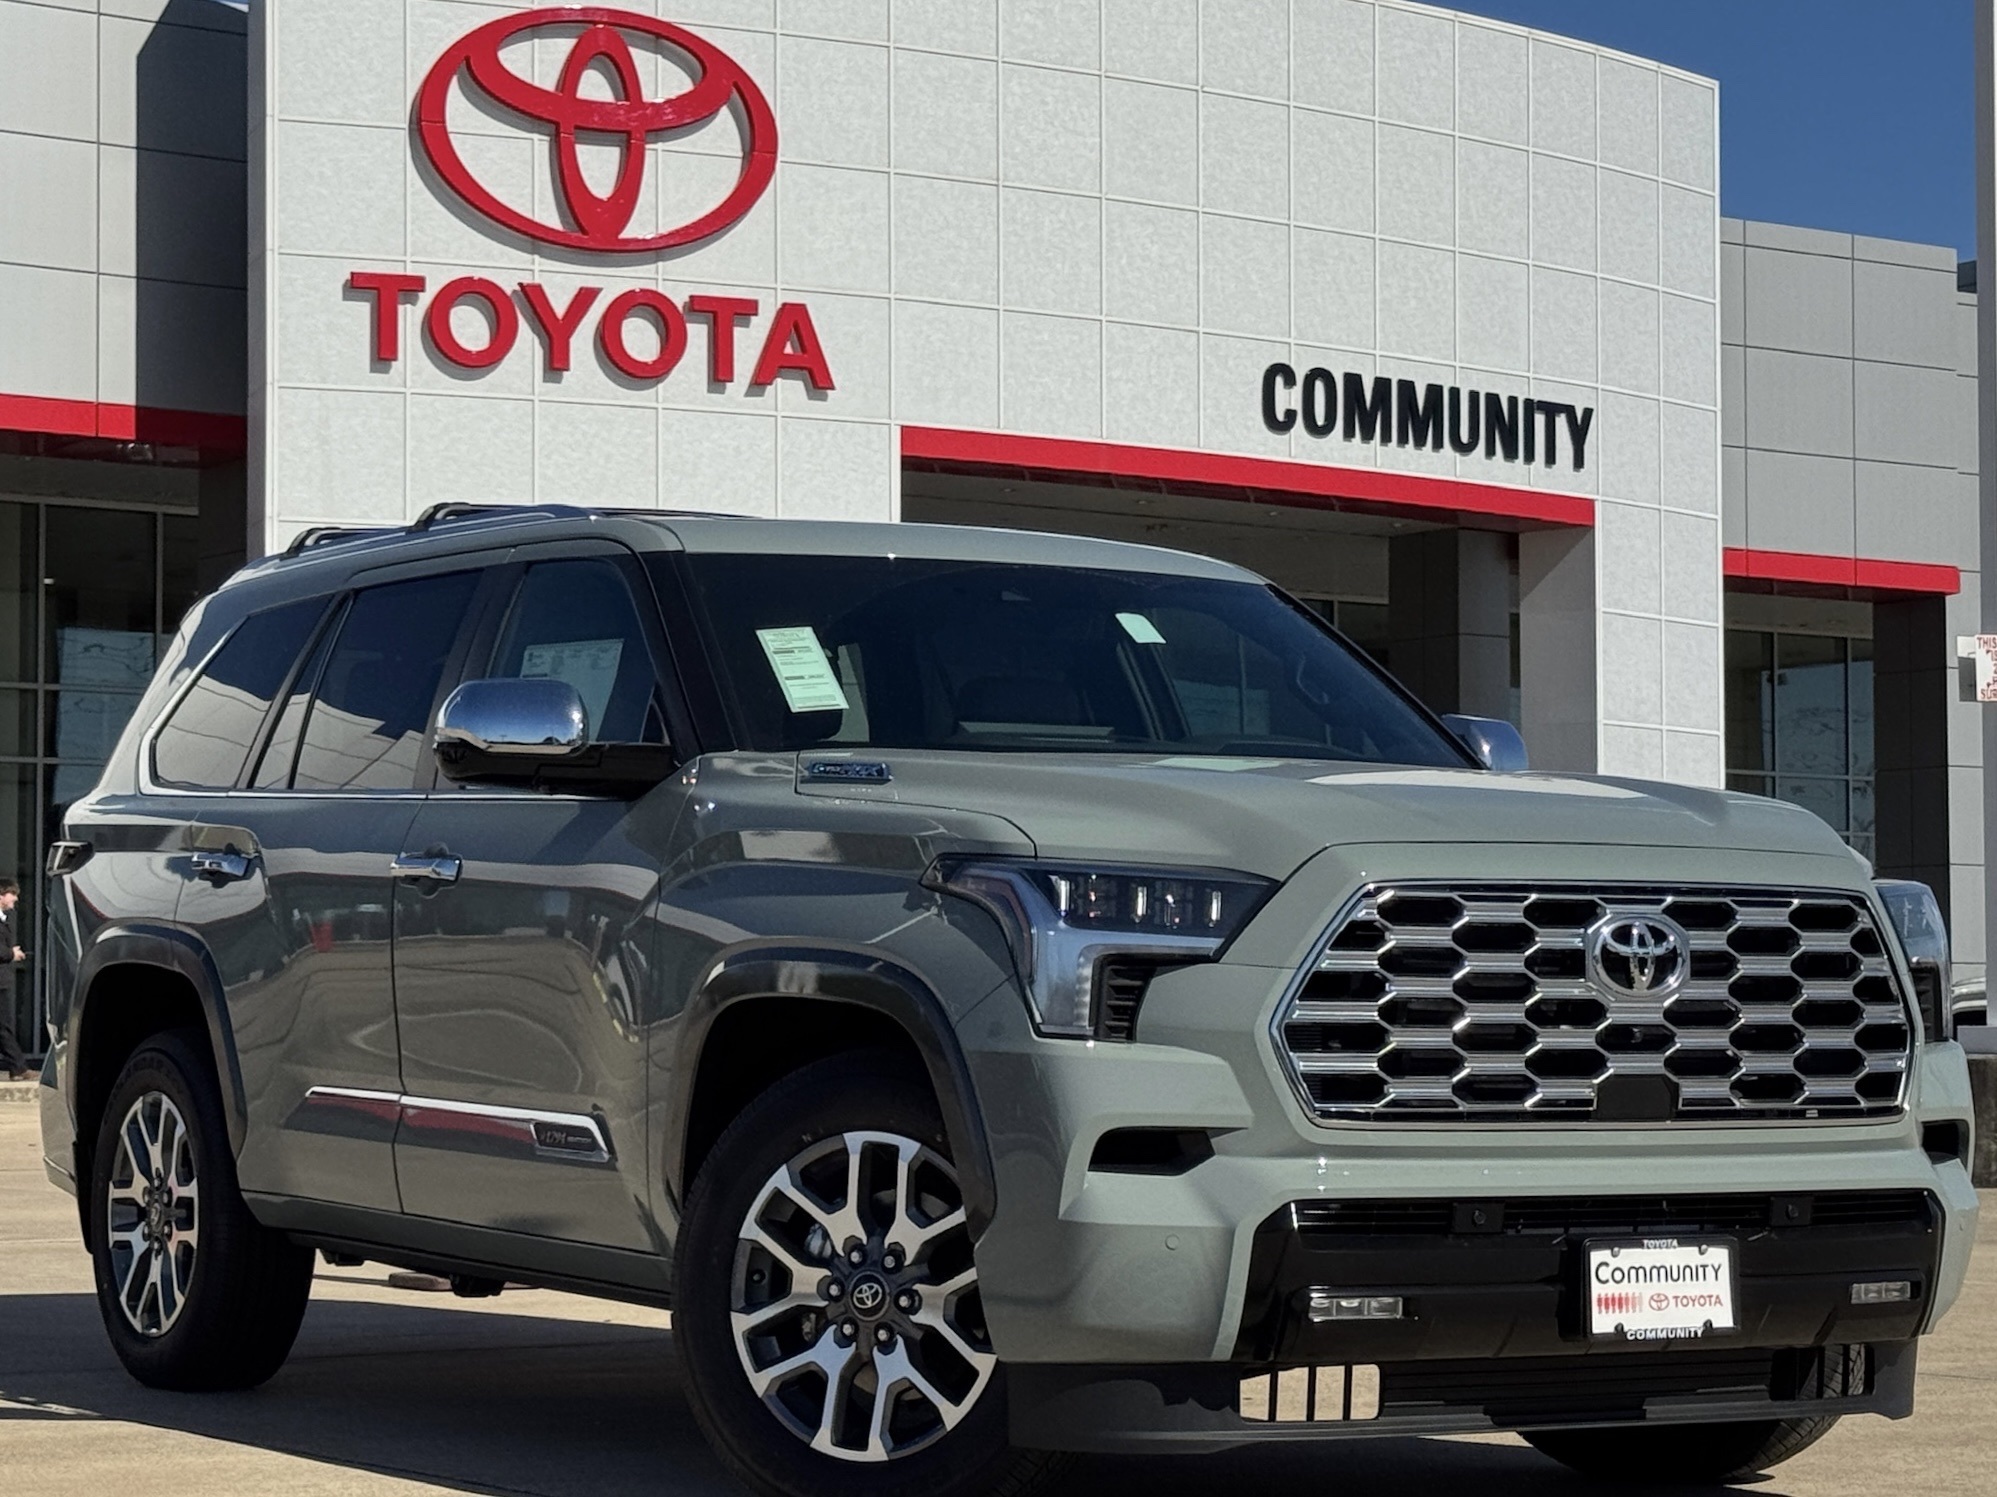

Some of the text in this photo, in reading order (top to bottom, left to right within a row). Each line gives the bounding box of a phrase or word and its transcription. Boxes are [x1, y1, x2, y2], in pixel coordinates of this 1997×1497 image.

[350, 271, 836, 390] TOYOTA
[1262, 362, 1594, 470] COMMUNITY
[1642, 1239, 1679, 1249] TOYOTA
[1673, 1295, 1723, 1307] TOYOTA
[1626, 1328, 1703, 1340] COMMUNITY
